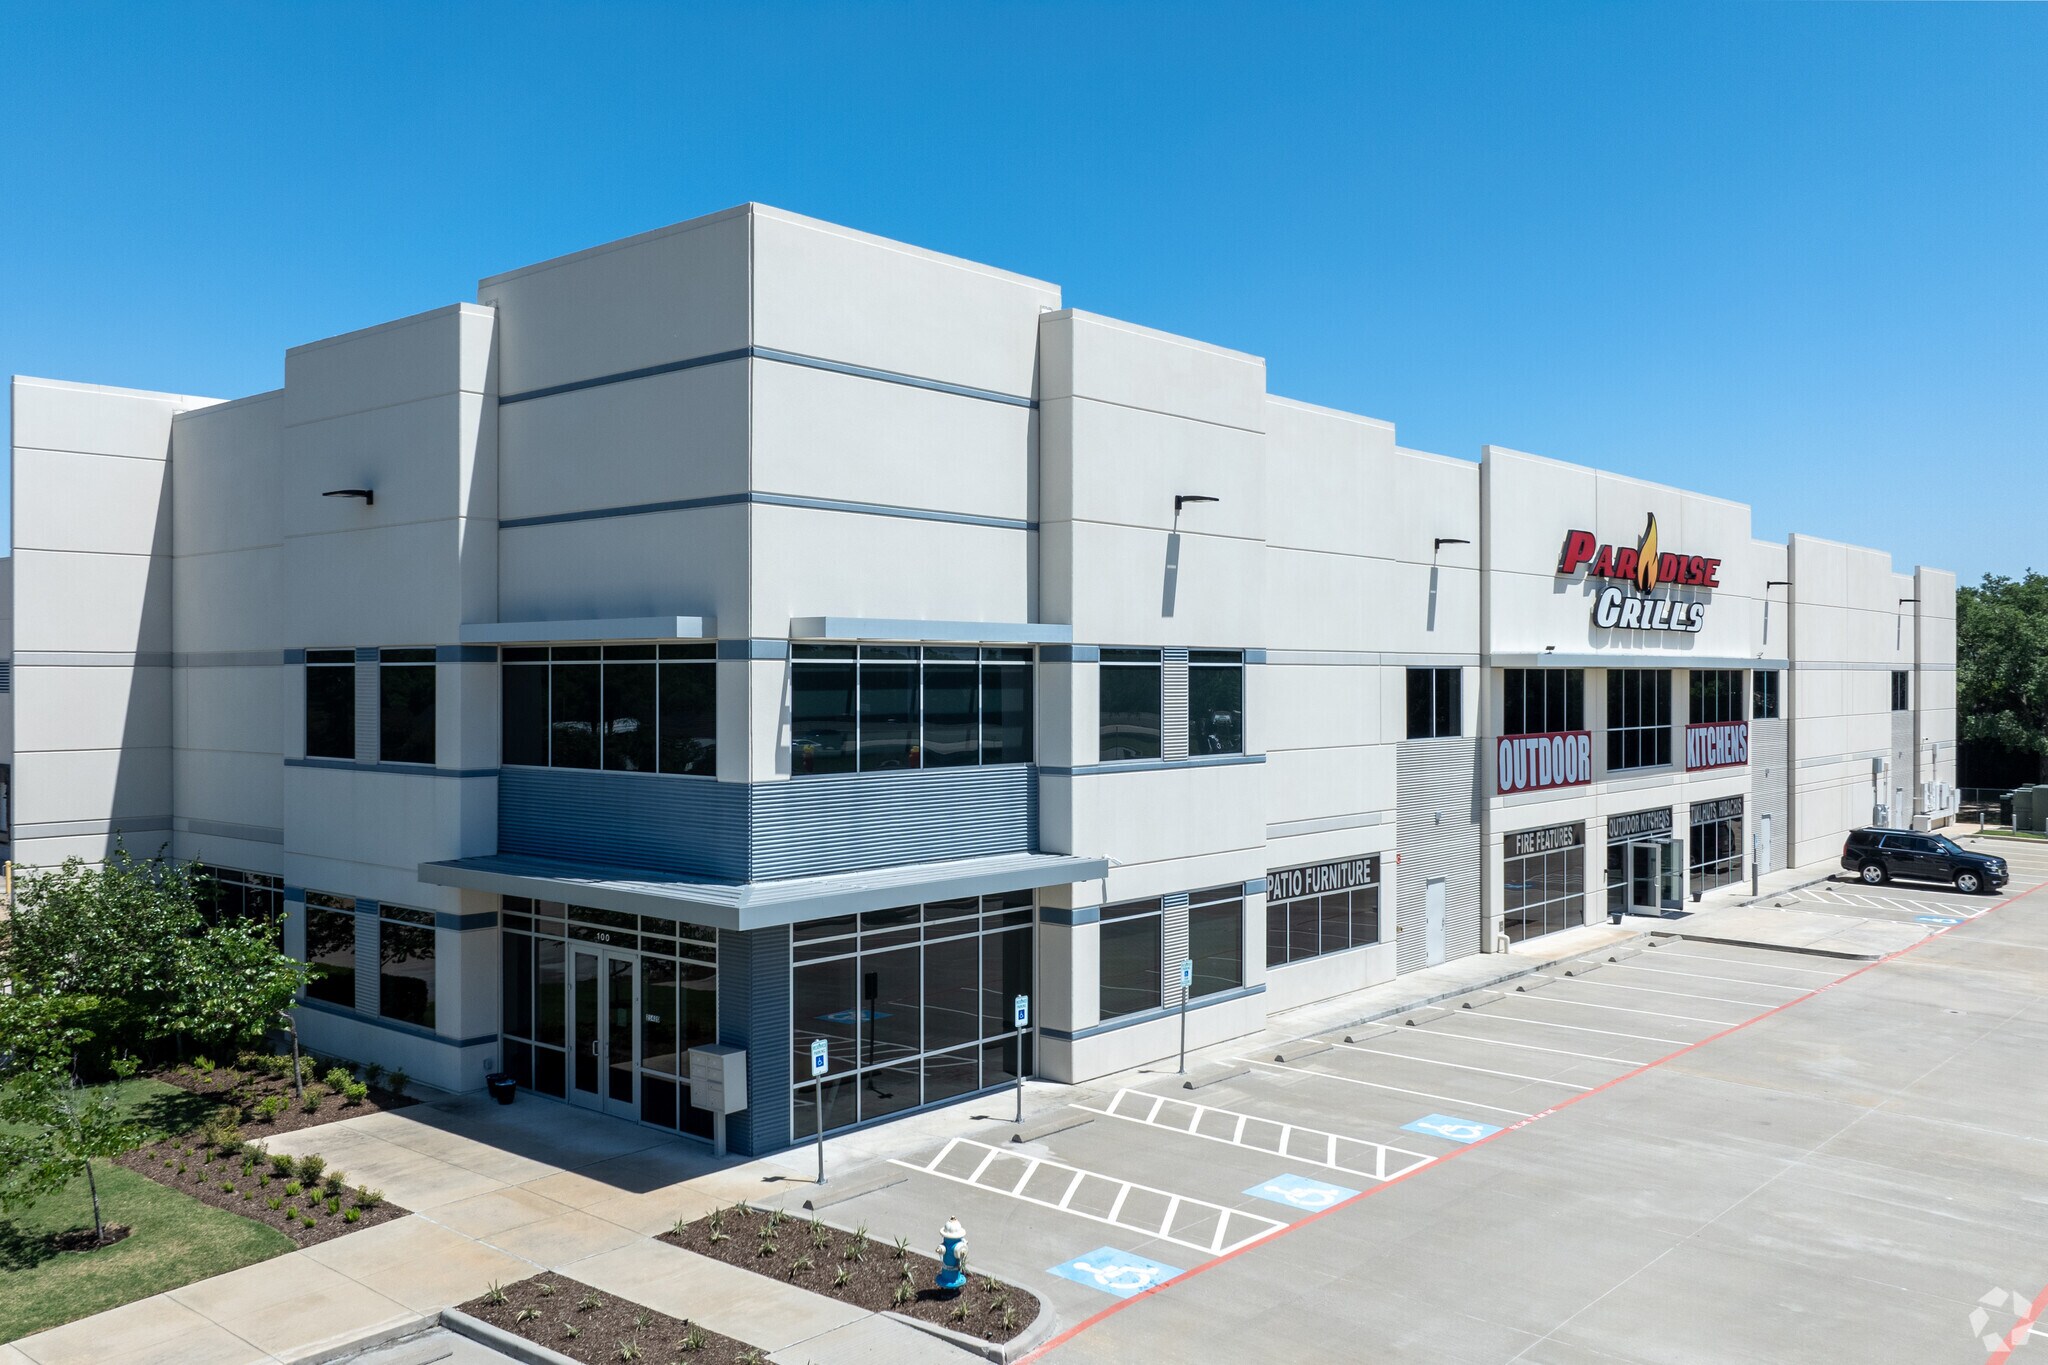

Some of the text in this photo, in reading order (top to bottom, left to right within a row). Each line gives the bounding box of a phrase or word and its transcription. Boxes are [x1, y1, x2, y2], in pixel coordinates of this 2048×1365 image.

[1593, 586, 1705, 633] GRILLS
[1499, 734, 1590, 791] OUTDOOR
[1686, 724, 1747, 768] KITCHENS
[1608, 809, 1670, 837] OUTDOOR KITCHENS
[1702, 802, 1716, 820] HUTS
[1516, 826, 1573, 854] FIRE FEATURES
[1267, 859, 1371, 901] PATIO FURNITURE
[596, 932, 610, 942] 100
